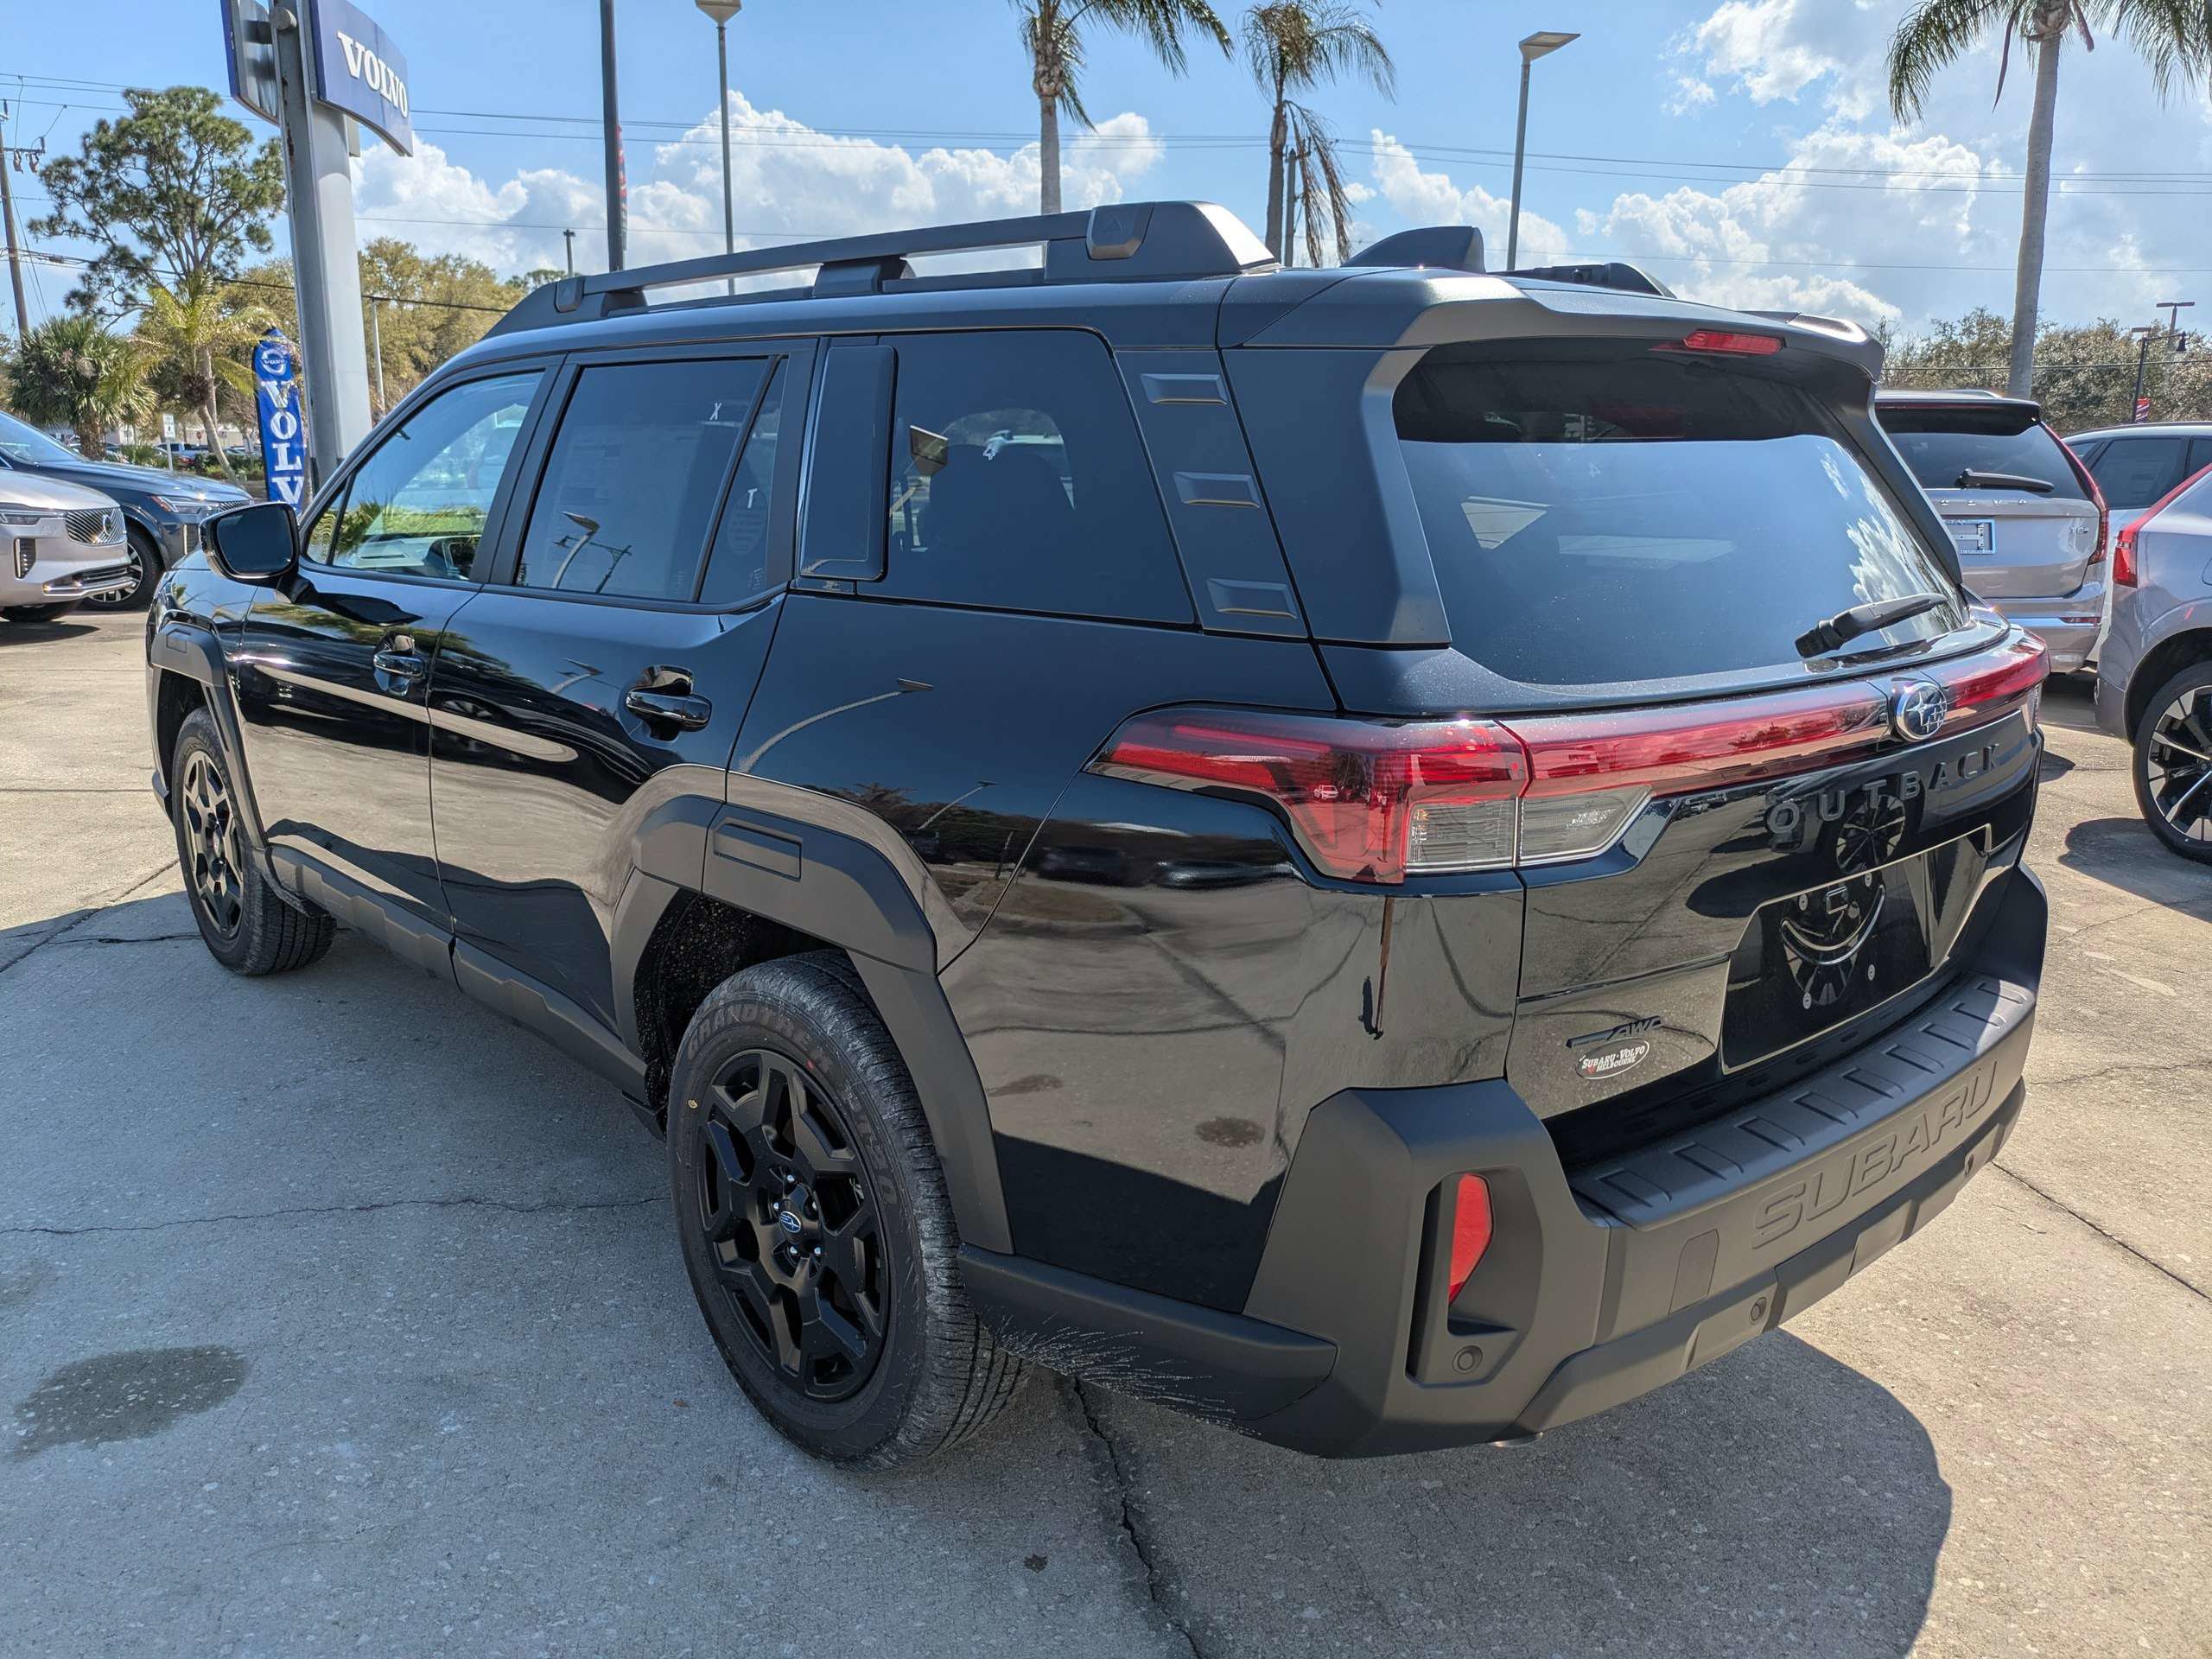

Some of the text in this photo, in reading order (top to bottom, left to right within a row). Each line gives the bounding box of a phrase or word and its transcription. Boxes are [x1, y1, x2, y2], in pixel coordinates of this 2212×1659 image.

[337, 30, 408, 118] VOLVO
[261, 380, 305, 506] VOLV
[1770, 743, 1999, 834] OUTBACK
[1751, 1060, 1998, 1250] SUBARU
